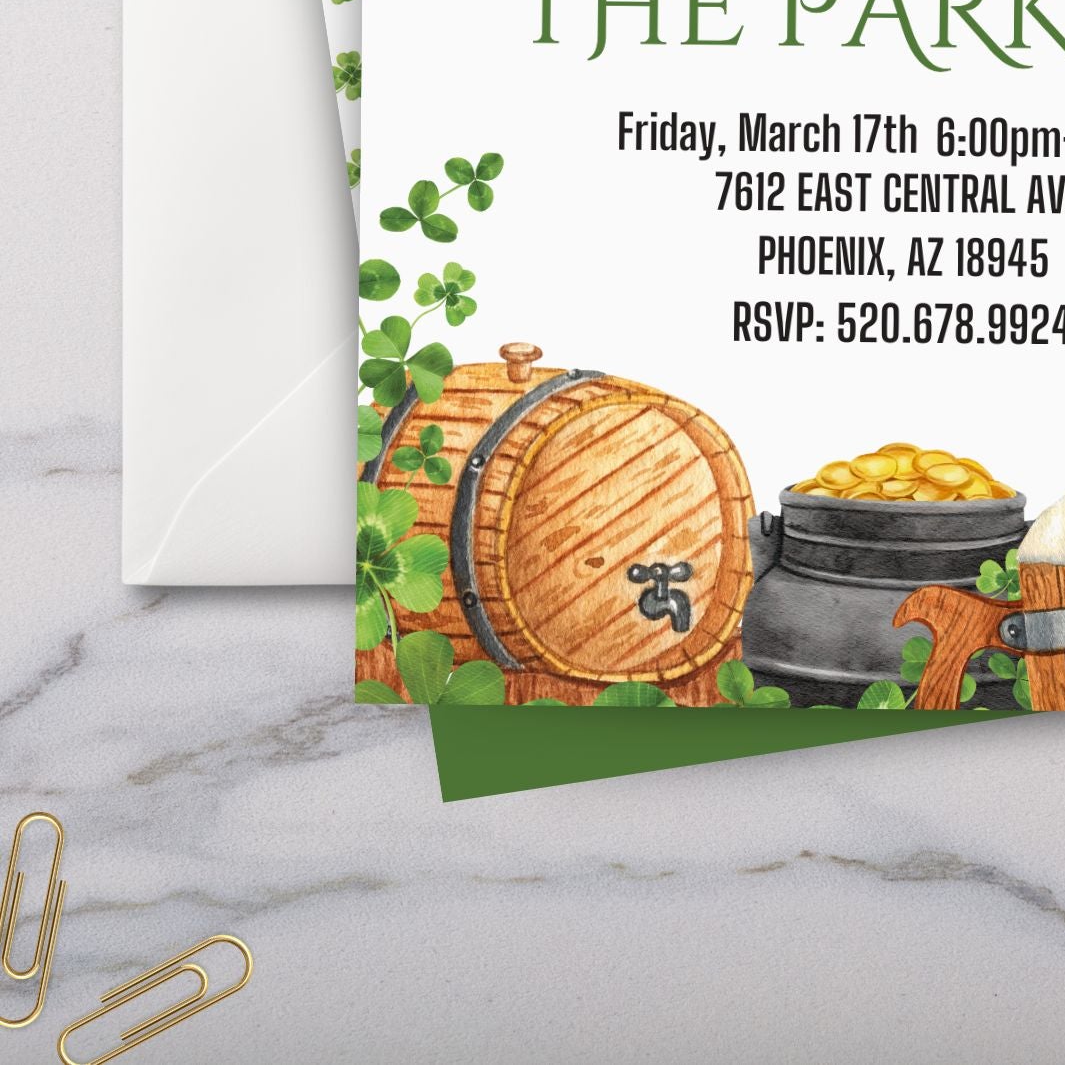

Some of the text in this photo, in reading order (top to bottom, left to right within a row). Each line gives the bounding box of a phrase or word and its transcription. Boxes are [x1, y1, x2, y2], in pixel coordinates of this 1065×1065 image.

[618, 110, 726, 162] Friday,
[738, 112, 841, 153] March
[852, 113, 918, 154] 17th
[715, 170, 786, 212] 7612
[797, 171, 873, 213] EAST
[883, 172, 1017, 214] CENTRAL
[758, 235, 1049, 282] PHOENIX, AZ 18945
[733, 300, 825, 343] RSVP:
